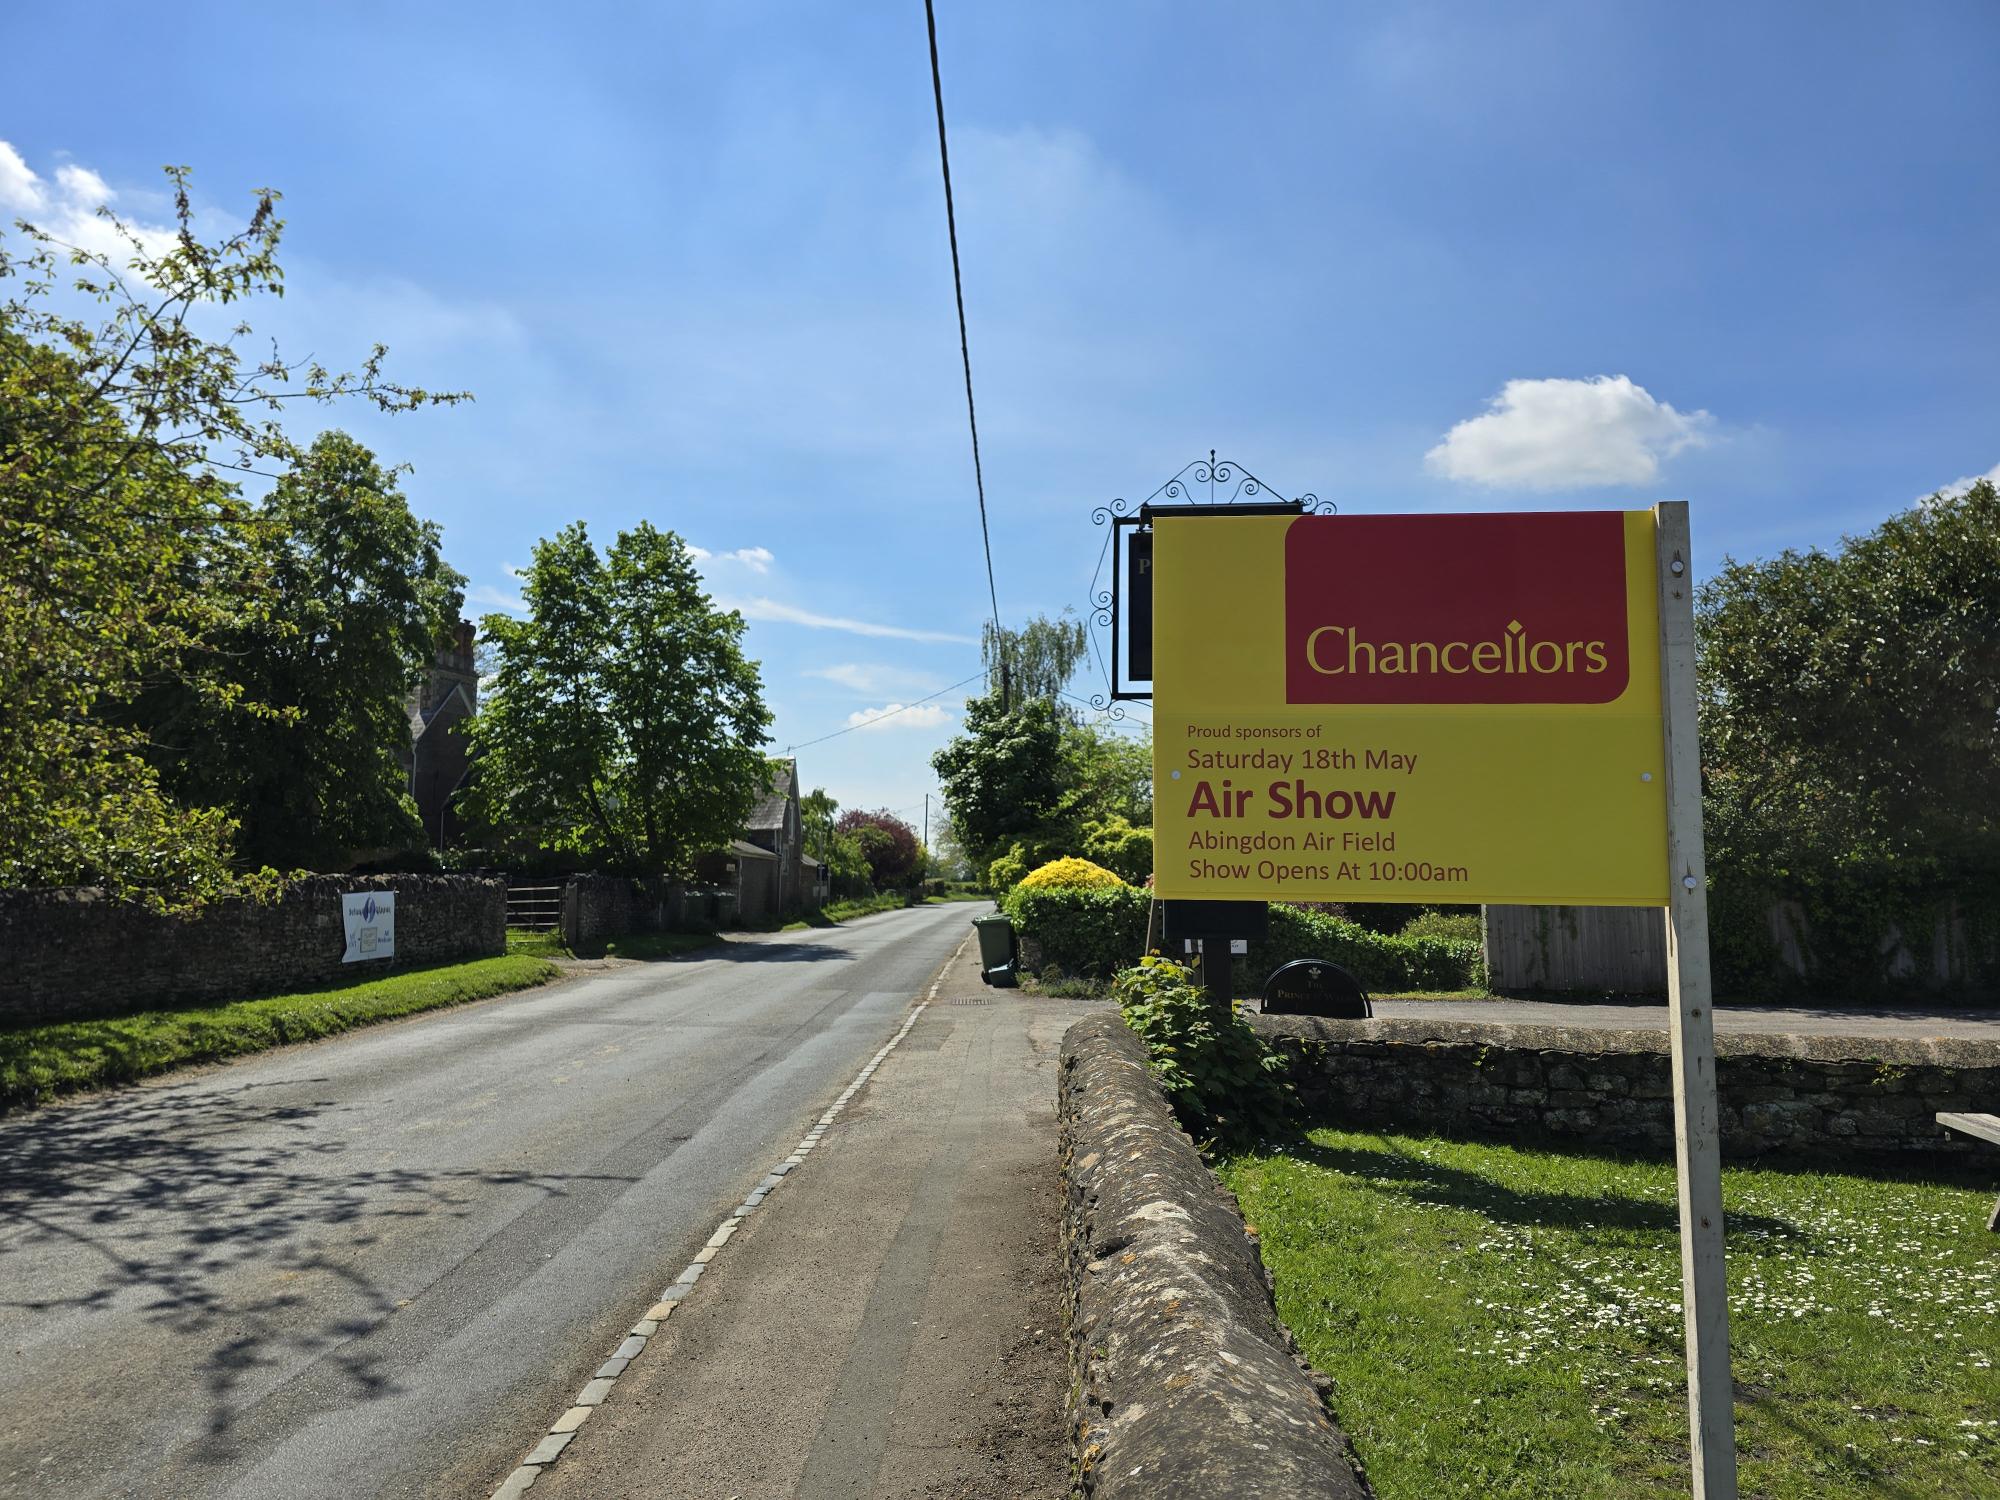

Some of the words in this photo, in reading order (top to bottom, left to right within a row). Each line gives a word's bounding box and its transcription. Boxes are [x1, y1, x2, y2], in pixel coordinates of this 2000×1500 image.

[1306, 620, 1608, 674] Chancellors
[1187, 725, 1231, 738] Proud
[1235, 727, 1301, 741] sponsors
[1306, 725, 1323, 738] of
[1187, 748, 1294, 774] Saturday
[1302, 748, 1356, 770] 18th
[1365, 749, 1418, 774] May
[1187, 779, 1254, 818] Air
[1268, 779, 1397, 819] Show
[1188, 830, 1295, 855] Abingdon
[1302, 832, 1336, 851] Air
[1343, 831, 1395, 852] Field
[1189, 859, 1250, 879] Show
[1257, 860, 1330, 884] Opens
[1336, 861, 1361, 881] At
[1369, 861, 1468, 882] 10:00am
